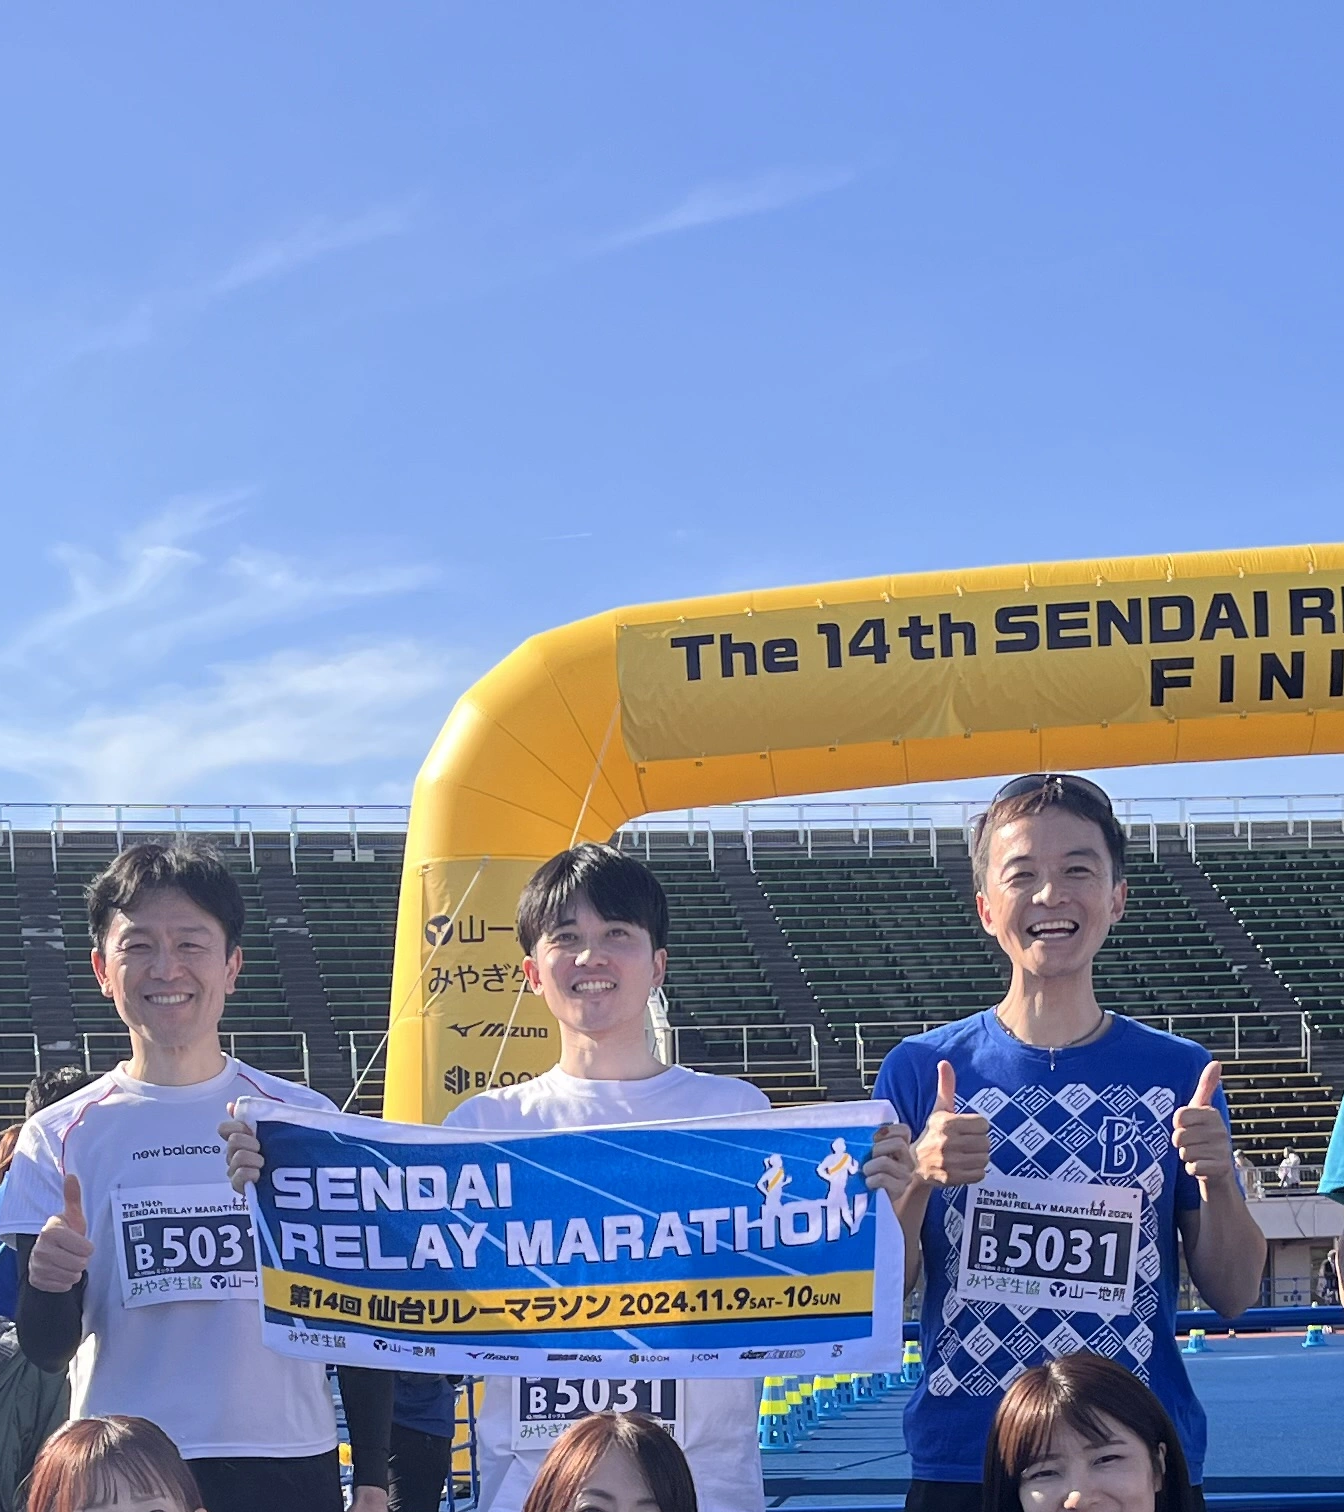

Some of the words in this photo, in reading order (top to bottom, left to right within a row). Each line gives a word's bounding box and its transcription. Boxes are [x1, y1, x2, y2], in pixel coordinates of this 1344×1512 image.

[670, 633, 798, 681] The
[817, 613, 977, 669] 14th
[995, 590, 1269, 654] SENDAI
[459, 915, 516, 943] 山一
[429, 963, 536, 994] みやぎ生
[475, 1071, 542, 1089] BLOO
[132, 1148, 161, 1161] new
[162, 1144, 222, 1157] balance
[271, 1162, 513, 1214] SENDAI
[123, 1209, 159, 1219] SENDAI
[161, 1207, 193, 1215] RELAY
[976, 1197, 1013, 1209] SENDAI
[1013, 1200, 1047, 1212] RELAY
[1050, 1204, 1106, 1217] MARATHON
[1108, 1210, 1133, 1219] 2024
[280, 1220, 491, 1275] RELAY
[504, 1195, 869, 1269] MARATHON
[134, 1243, 155, 1271] B
[978, 1235, 998, 1264] B
[1005, 1223, 1118, 1277] 5031
[131, 1275, 203, 1296] みやぎ生協
[229, 1274, 258, 1288] 山一
[966, 1273, 1040, 1295] みやぎ生協
[1069, 1284, 1126, 1302] 山一地所
[290, 1283, 362, 1319] 第14回
[367, 1283, 611, 1326] 仙台リレーマラソン
[529, 1386, 547, 1414] B
[555, 1378, 662, 1414] 5031
[520, 1422, 572, 1439] みやぎ
